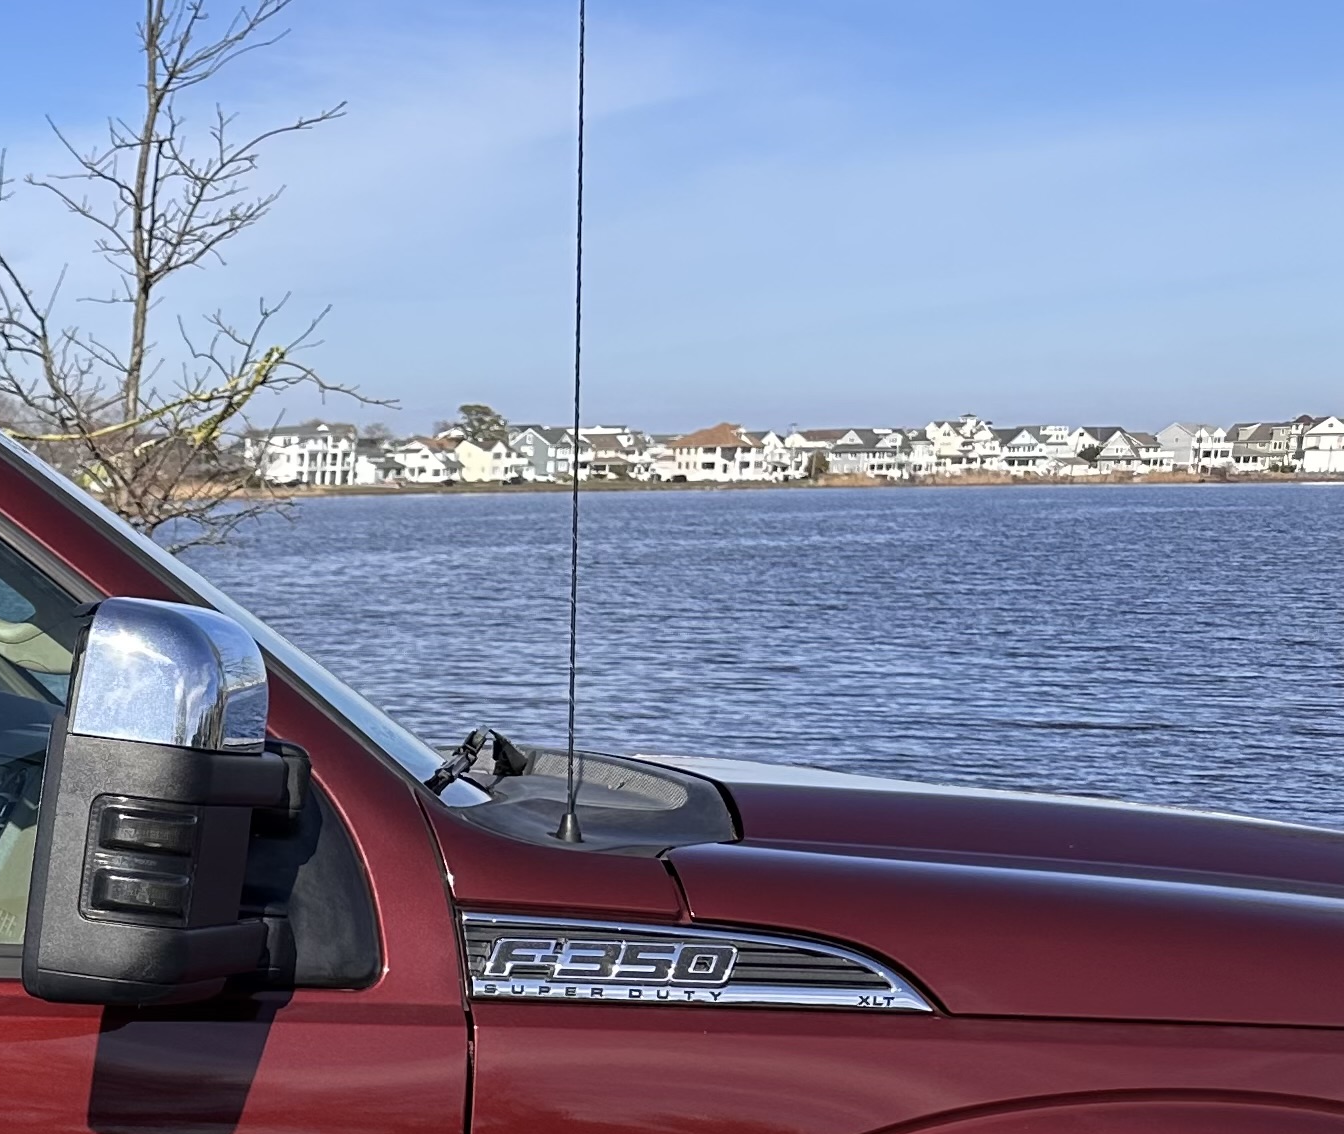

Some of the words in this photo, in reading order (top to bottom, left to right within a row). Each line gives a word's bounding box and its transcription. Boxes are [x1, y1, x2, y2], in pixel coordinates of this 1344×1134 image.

[483, 983, 605, 998] SUPER
[628, 988, 723, 1002] DUTY
[857, 995, 896, 1007] XLT
